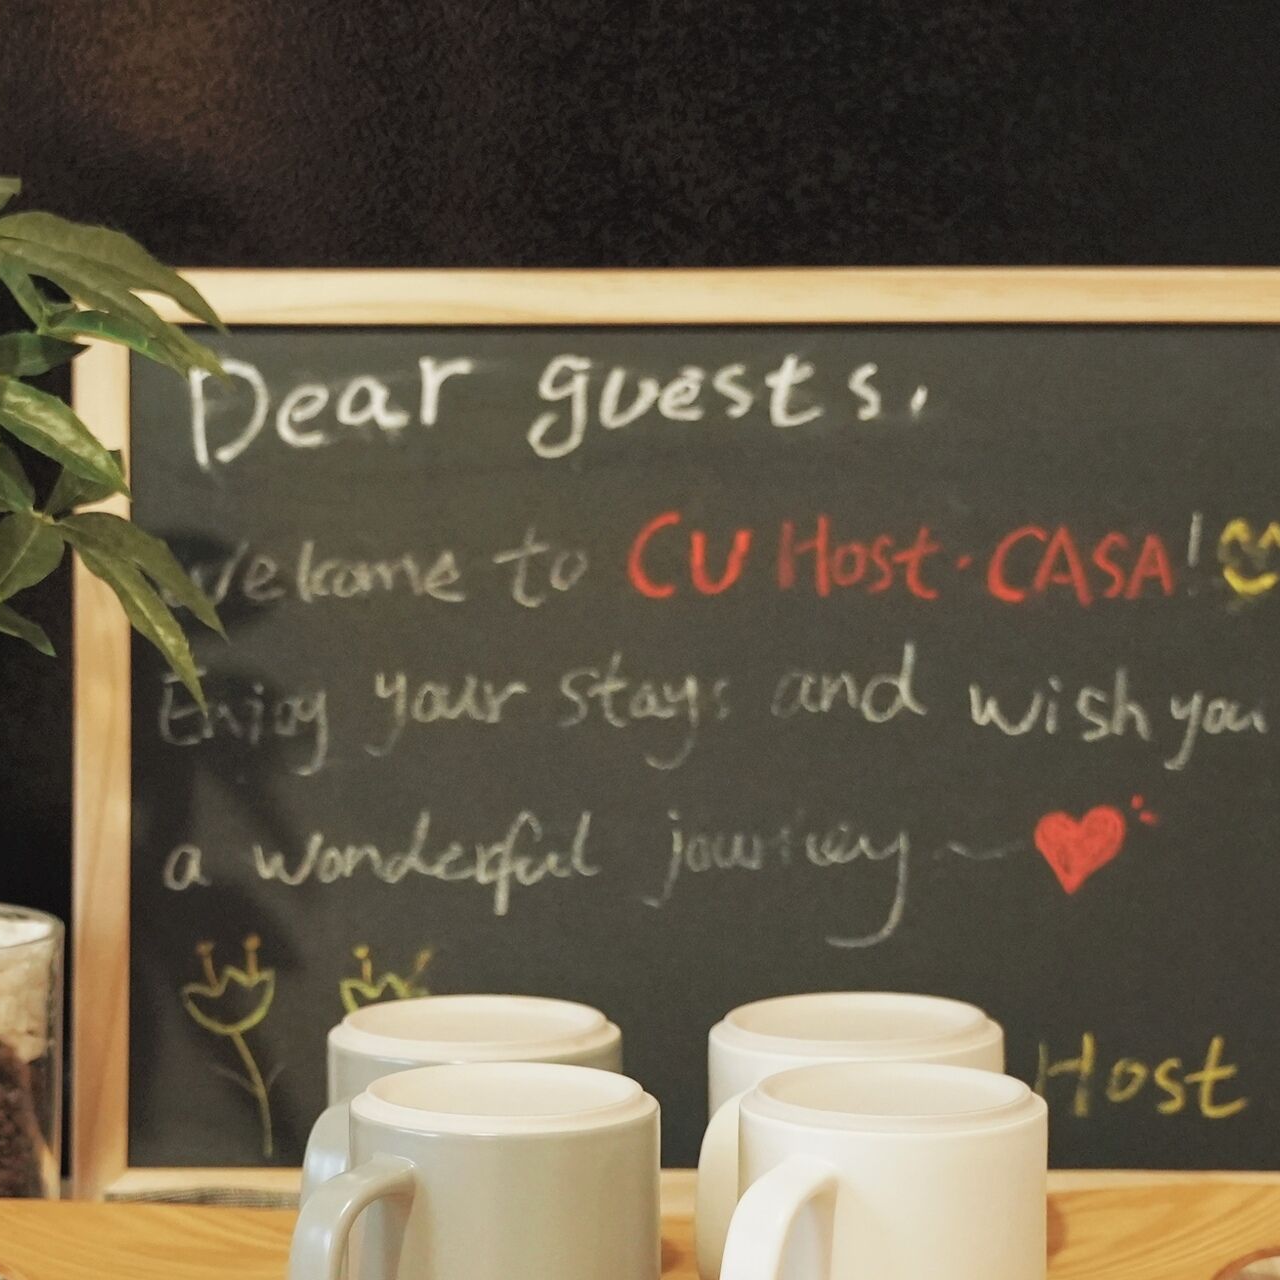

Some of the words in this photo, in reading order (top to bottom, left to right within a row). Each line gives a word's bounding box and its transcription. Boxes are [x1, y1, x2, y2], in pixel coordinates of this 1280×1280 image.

[188, 355, 475, 470] Dear
[528, 352, 928, 458] guests,
[494, 522, 588, 608] to
[626, 511, 754, 599] CU
[365, 671, 528, 758] your
[770, 641, 928, 724] and
[968, 663, 1152, 743] wish
[1162, 690, 1269, 770] you
[163, 843, 212, 891] a
[251, 809, 602, 917] wonderful
[1034, 1031, 1249, 1120] Host
